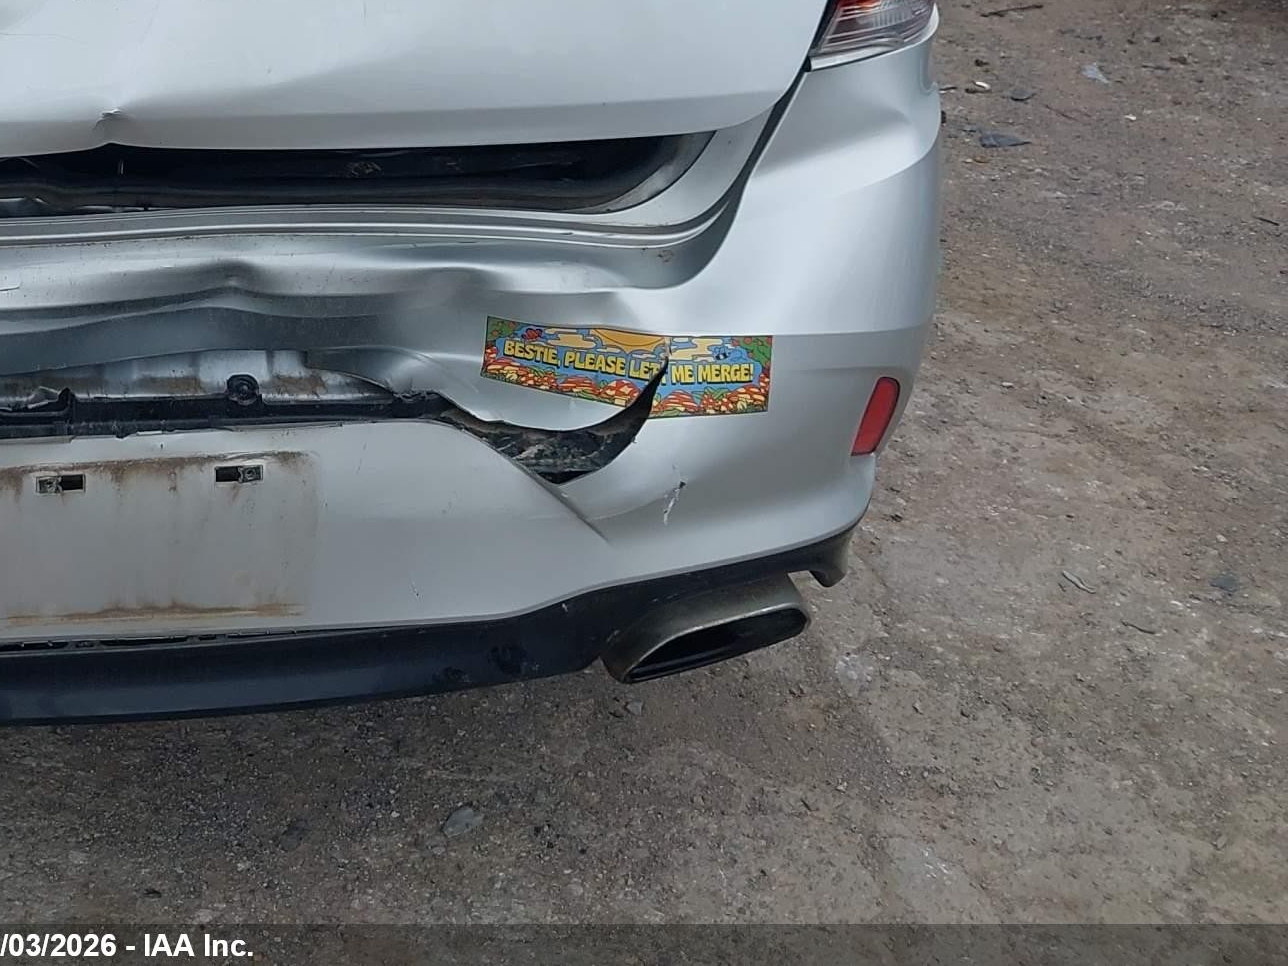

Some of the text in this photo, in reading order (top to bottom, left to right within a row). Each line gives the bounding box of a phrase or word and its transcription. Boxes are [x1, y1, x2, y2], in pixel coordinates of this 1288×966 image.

[563, 350, 626, 377] PLEASE
[670, 364, 696, 386] ME
[697, 362, 755, 384] MERGE!
